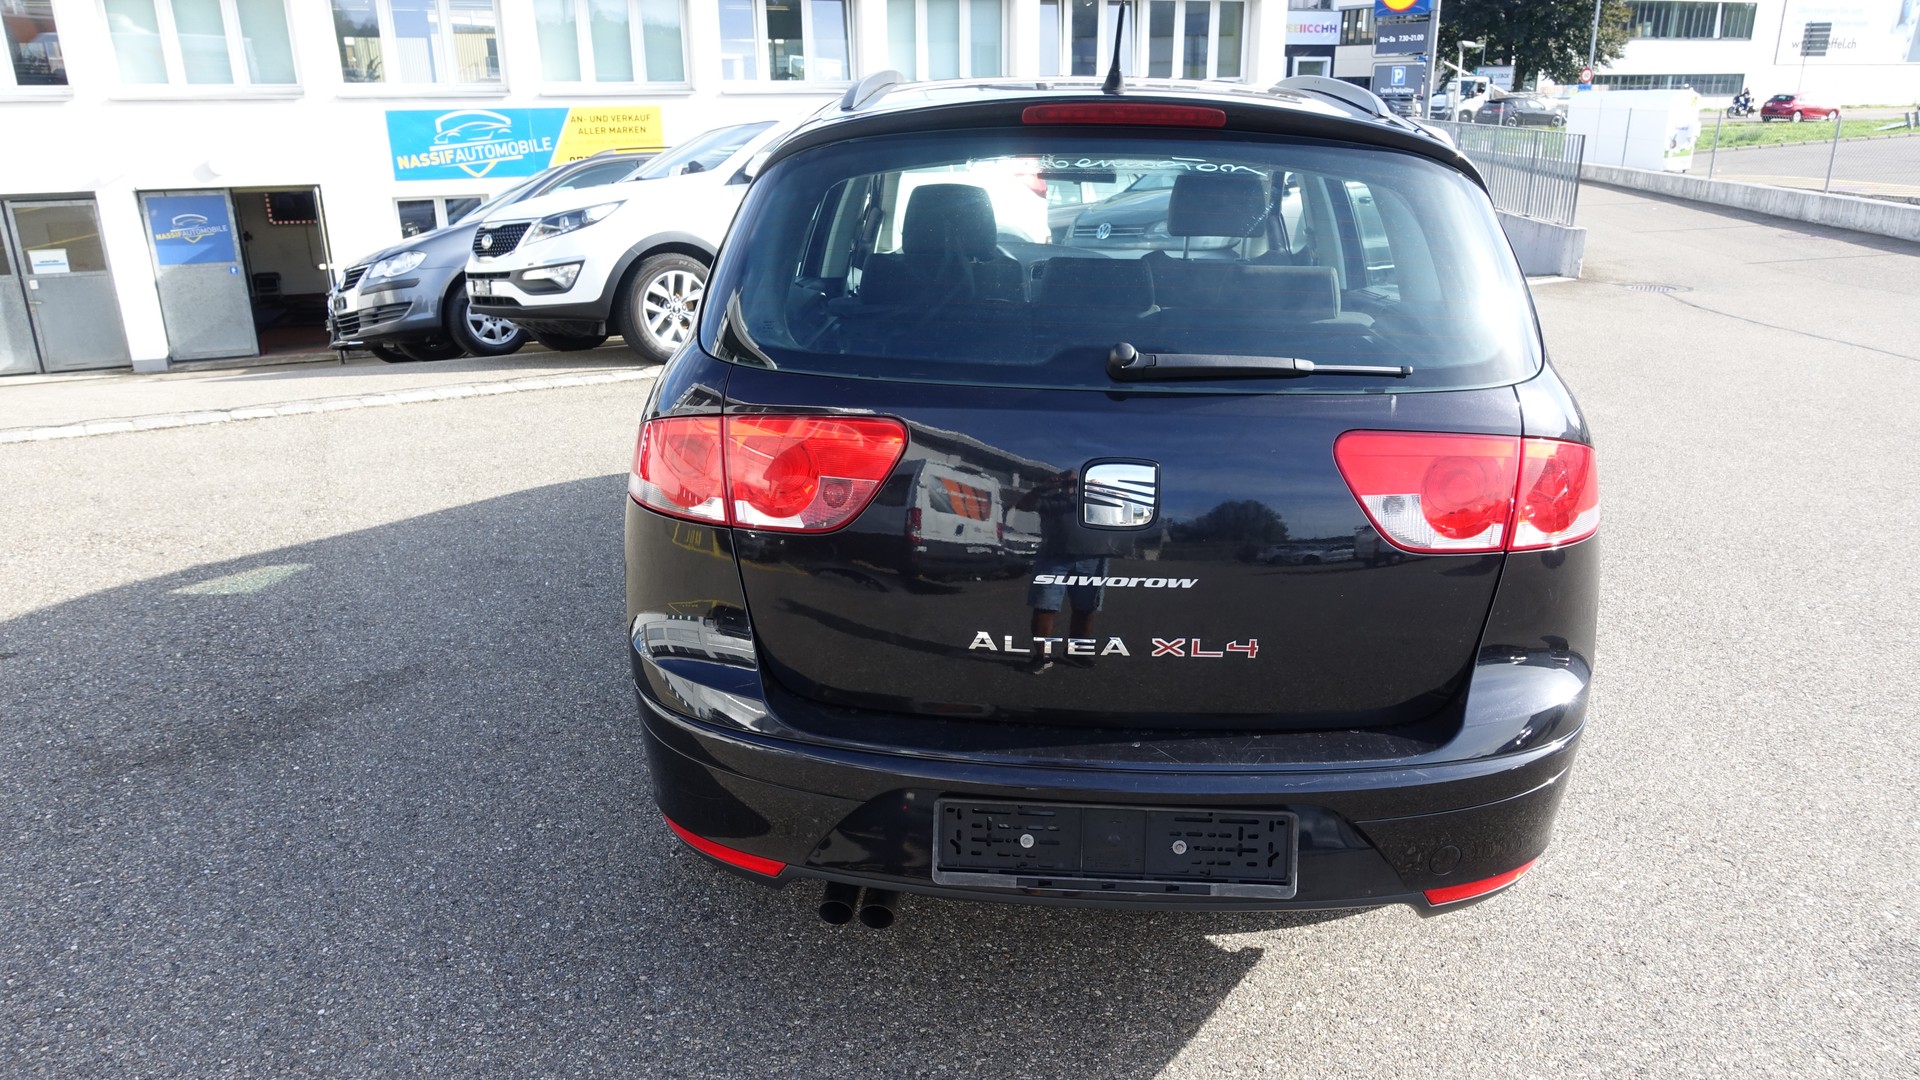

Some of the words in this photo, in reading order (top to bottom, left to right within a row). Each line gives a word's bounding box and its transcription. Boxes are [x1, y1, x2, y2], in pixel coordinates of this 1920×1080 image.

[1287, 24, 1338, 34] EEIICCHH
[570, 115, 588, 123] AN-
[589, 115, 609, 123] UND
[611, 114, 651, 122] VERKAUF
[578, 127, 606, 135] ALLER
[609, 126, 647, 134] MARKEN
[1033, 574, 1199, 589] suworow
[968, 630, 1131, 657] ALTEA
[1151, 637, 1259, 659] XL4
